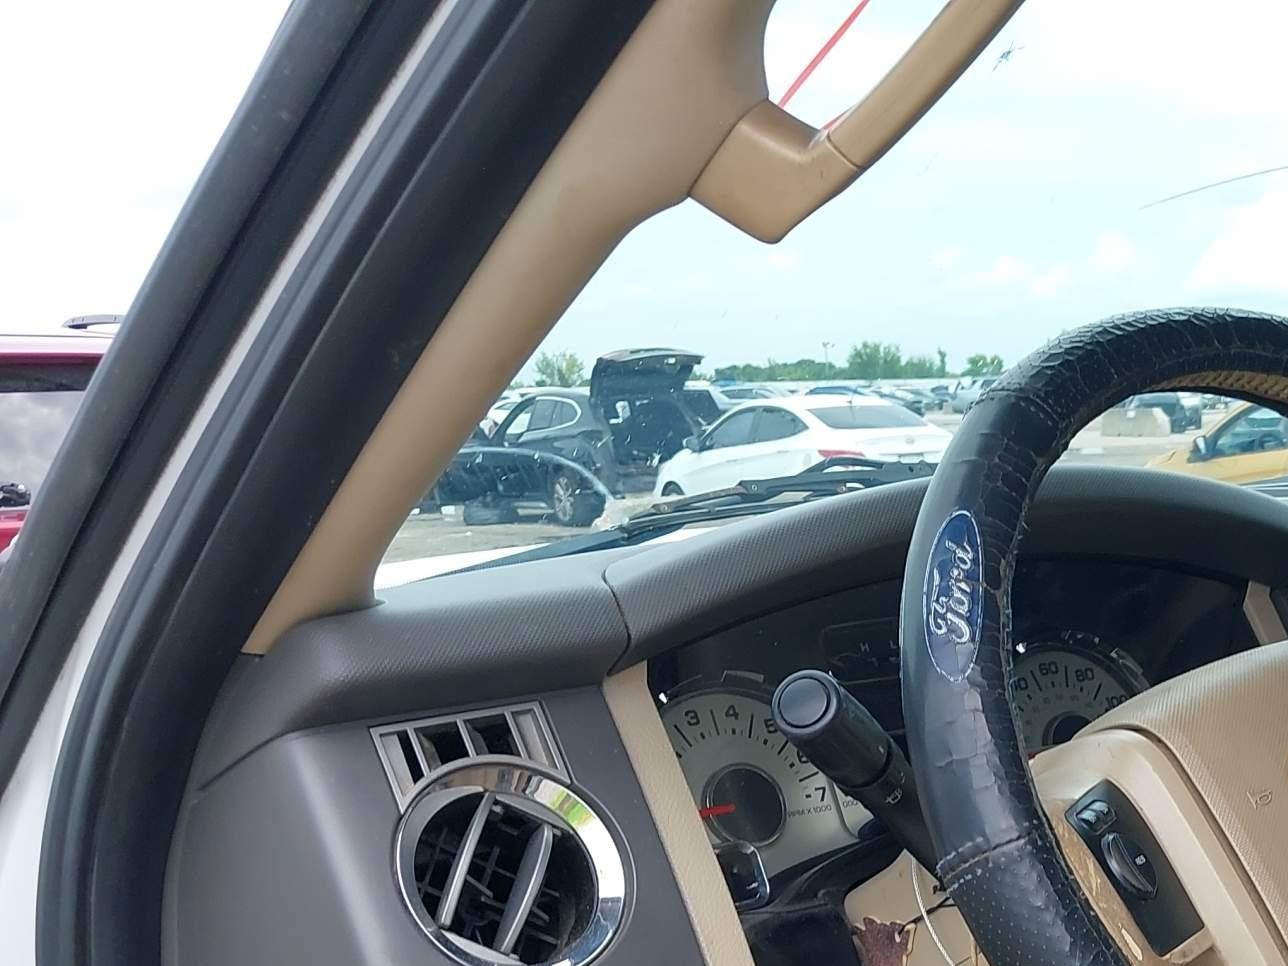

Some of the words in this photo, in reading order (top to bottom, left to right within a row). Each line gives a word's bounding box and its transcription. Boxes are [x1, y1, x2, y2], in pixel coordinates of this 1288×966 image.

[927, 539, 975, 644] Ford
[1038, 661, 1059, 676] 60
[1075, 667, 1095, 683] 80
[685, 709, 701, 726] 3
[725, 705, 739, 721] 4
[815, 786, 827, 802] 7
